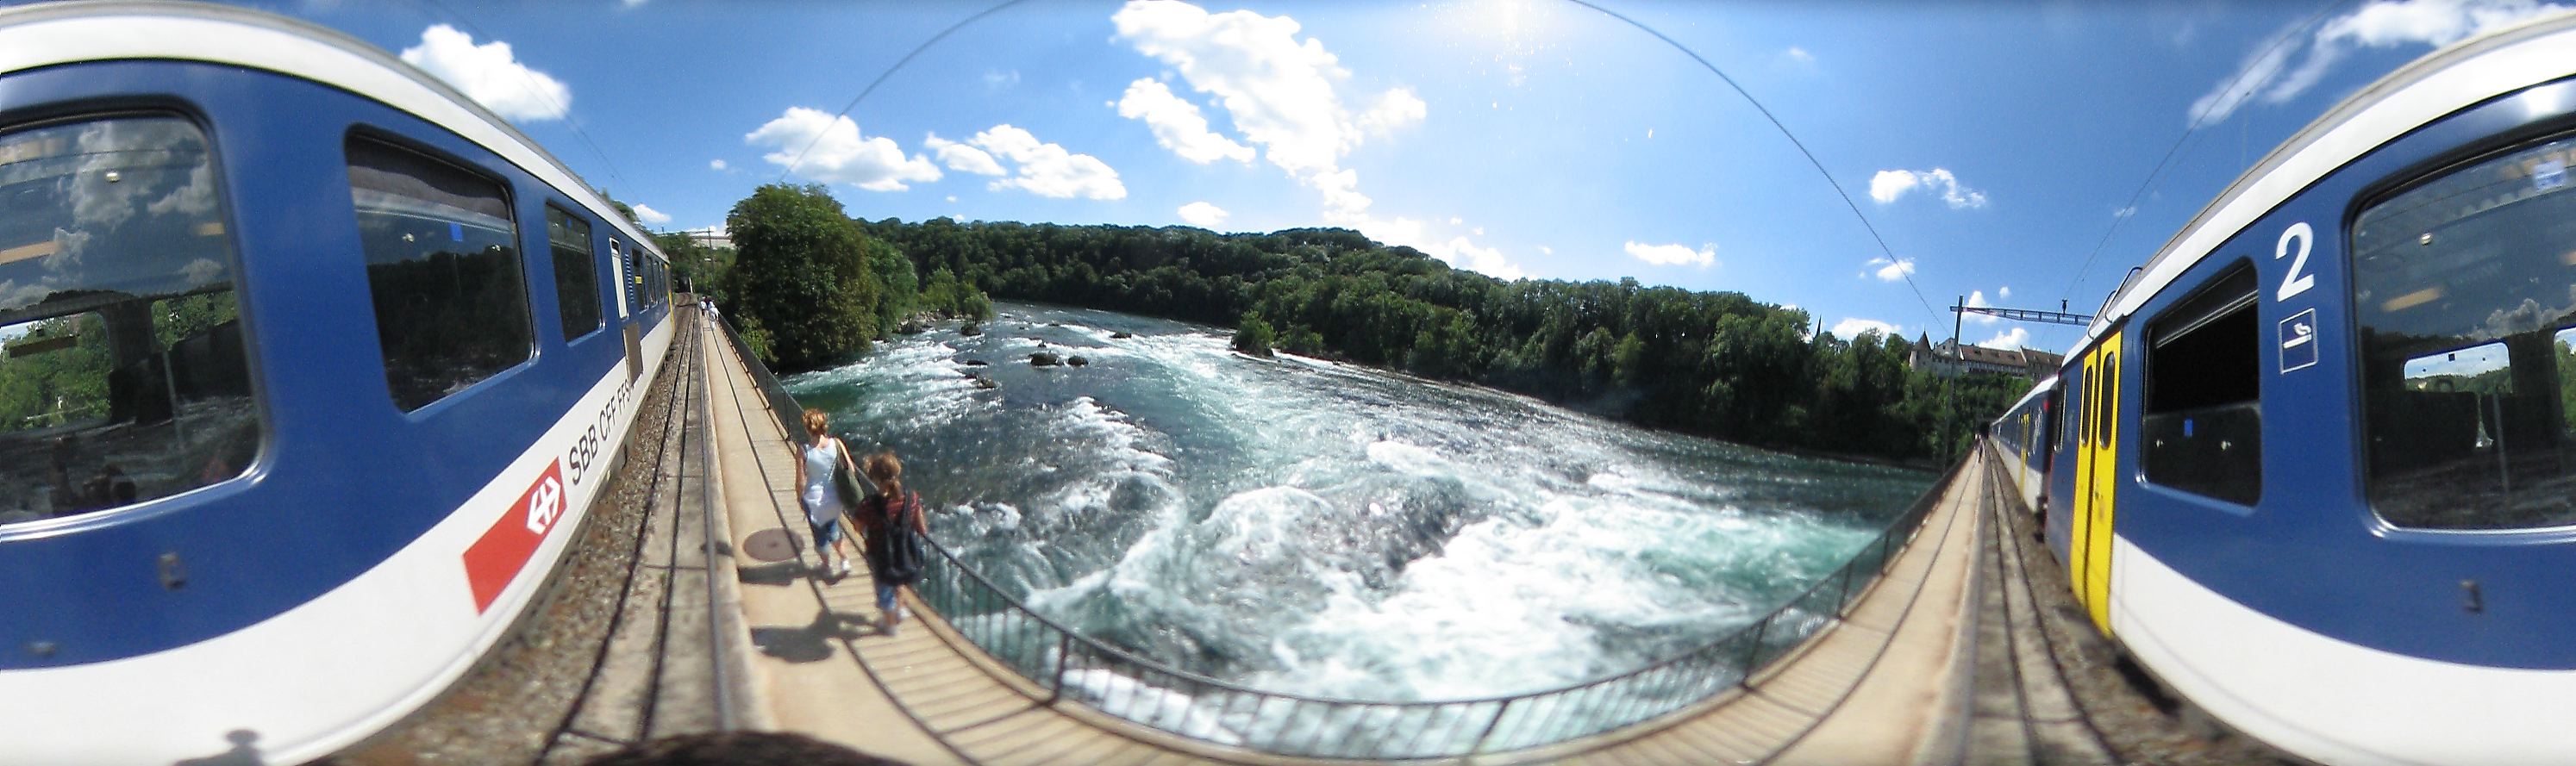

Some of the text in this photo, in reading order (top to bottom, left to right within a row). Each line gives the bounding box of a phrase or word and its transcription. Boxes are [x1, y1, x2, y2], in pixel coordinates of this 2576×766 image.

[2276, 222, 2314, 302] 2
[569, 379, 630, 486] SBB CFF FFS
